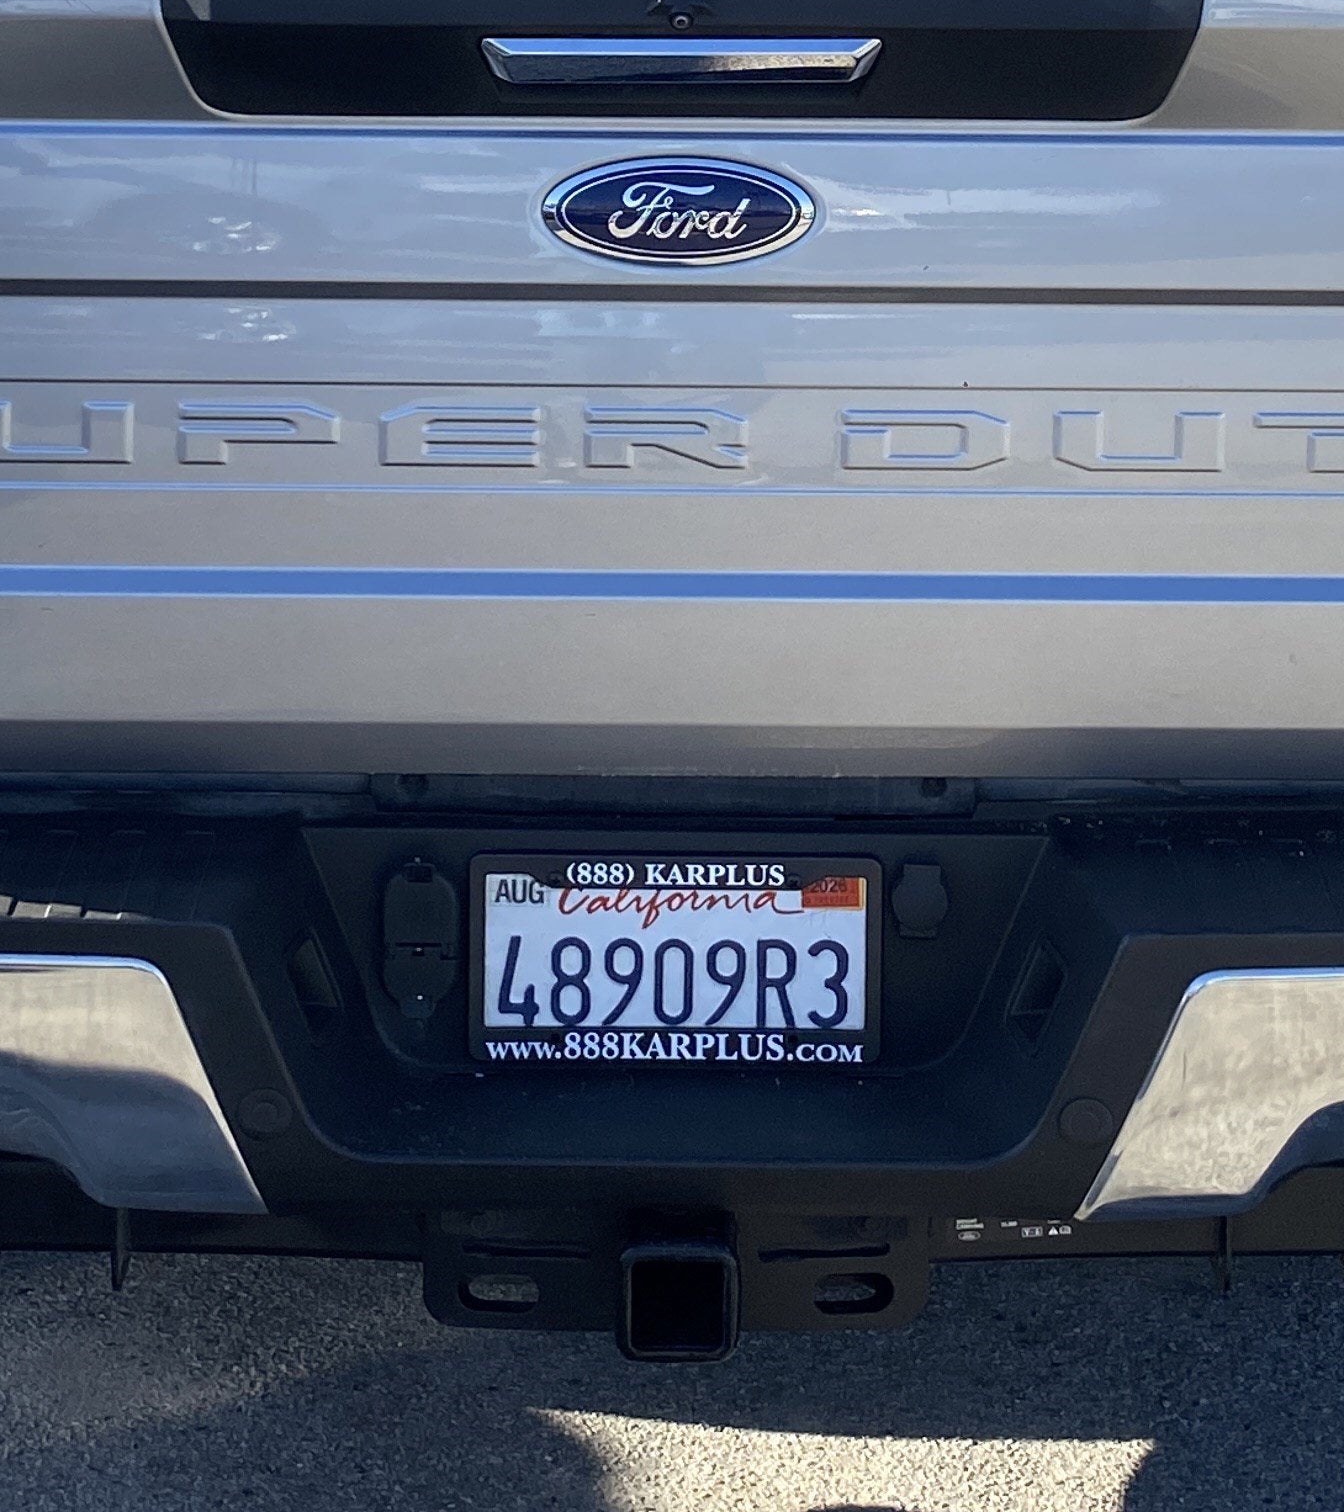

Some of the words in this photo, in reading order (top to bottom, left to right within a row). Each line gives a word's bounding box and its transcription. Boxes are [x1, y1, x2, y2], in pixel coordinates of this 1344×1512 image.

[607, 181, 751, 238] Ford
[494, 879, 545, 905] AUG
[566, 862, 635, 886] (888)
[644, 862, 786, 886] KARPLUS
[558, 887, 805, 929] California
[497, 935, 850, 1028] 48909R3
